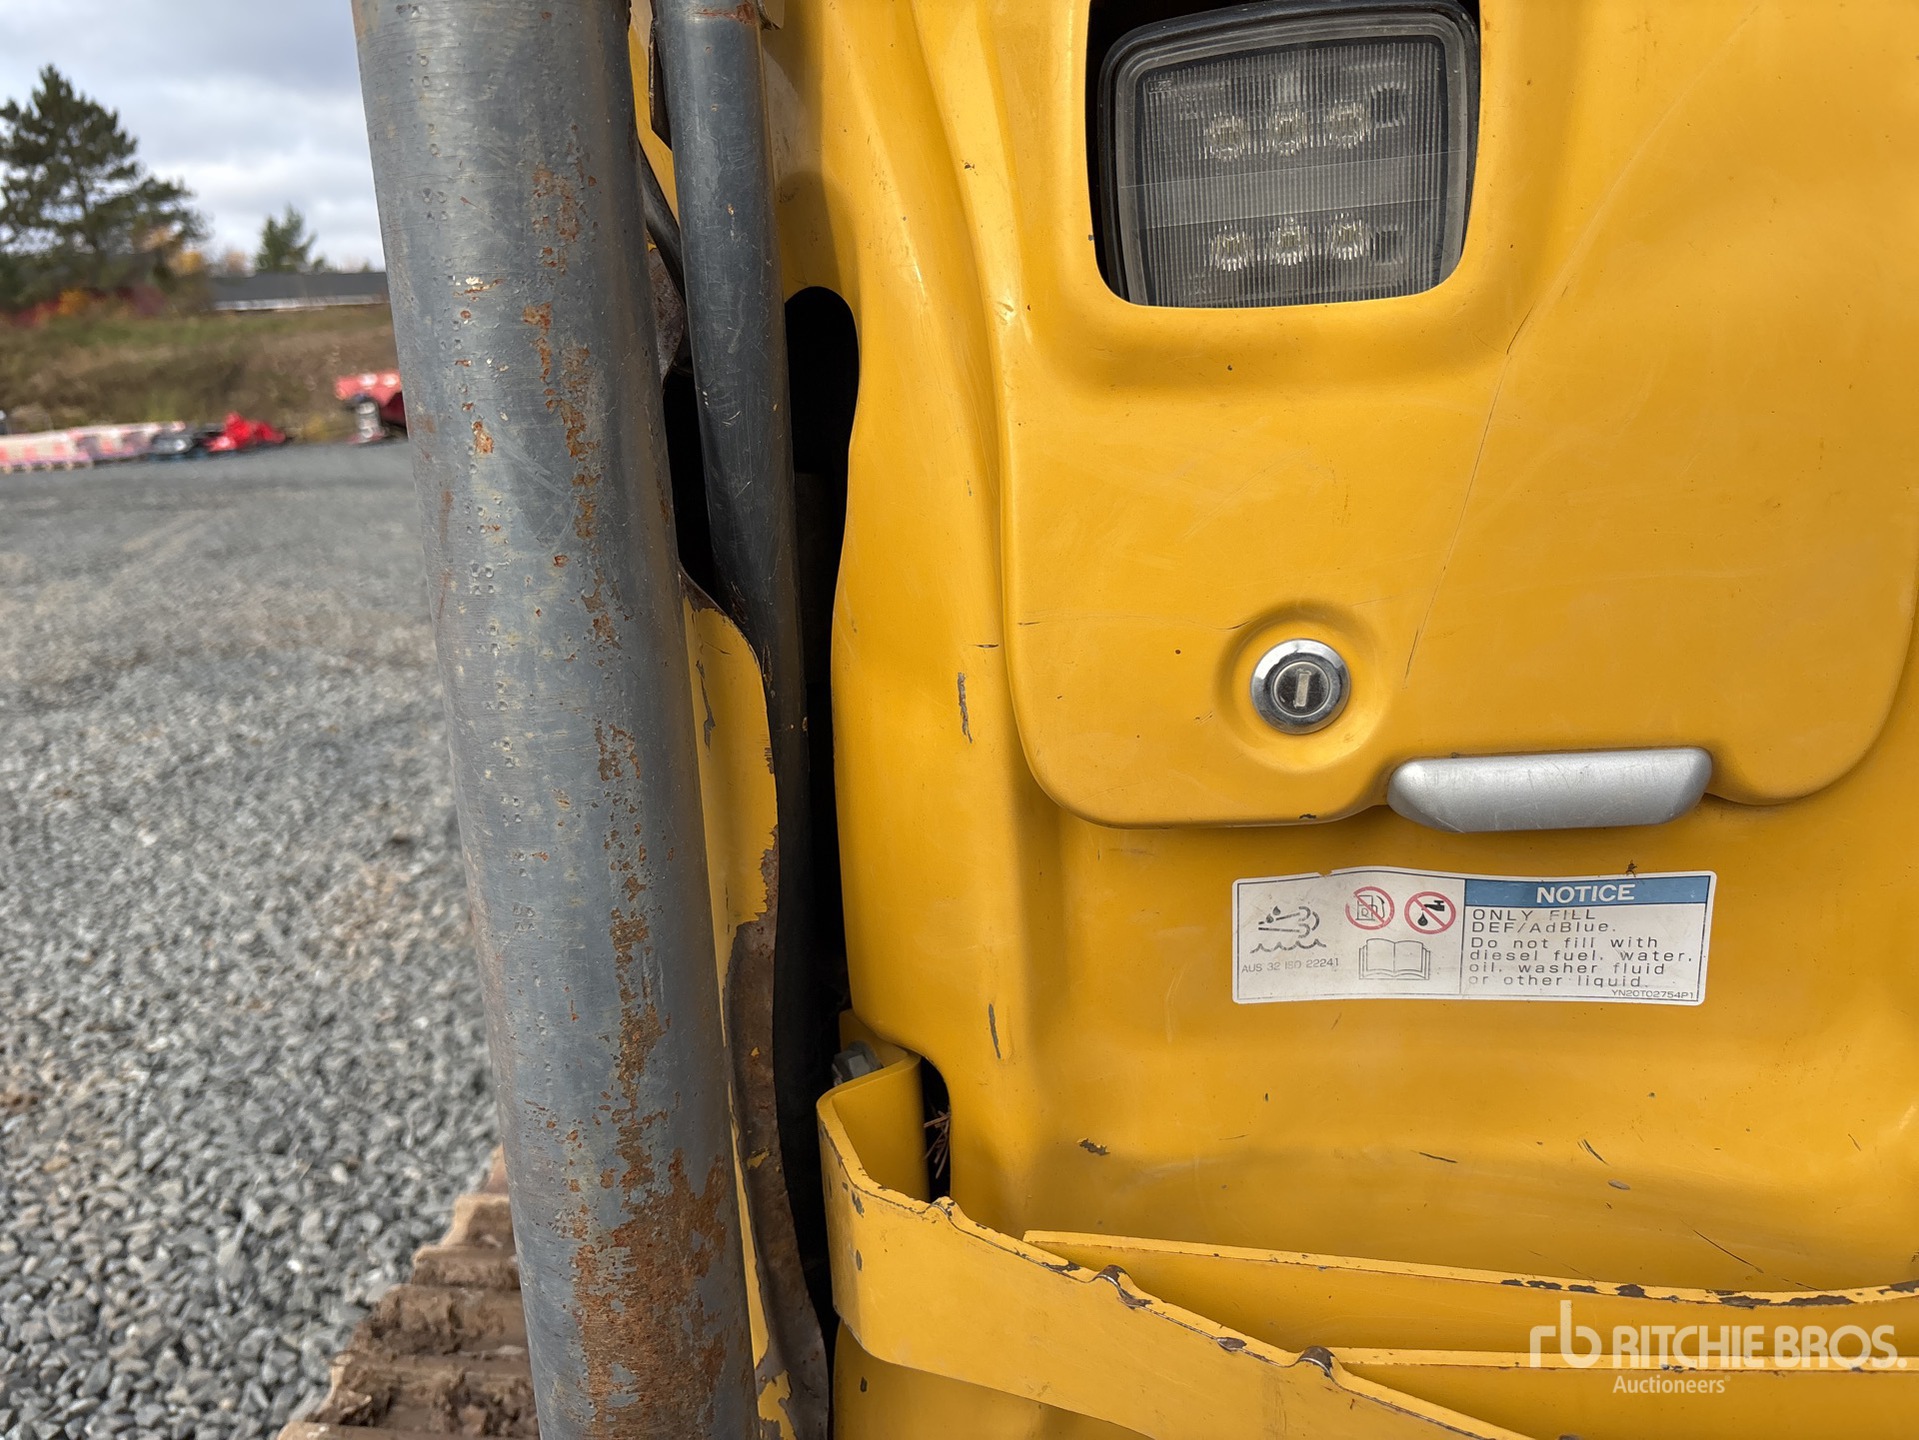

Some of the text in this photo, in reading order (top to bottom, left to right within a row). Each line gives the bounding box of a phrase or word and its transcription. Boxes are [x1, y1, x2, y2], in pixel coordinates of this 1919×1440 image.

[1536, 883, 1636, 904] NOTICE
[1472, 908, 1596, 921] ONLY FILL
[1471, 936, 1658, 949] Do not fill with
[1470, 951, 1538, 962] diesel
[1242, 958, 1339, 973] AUS 32 ISO 22241
[1518, 963, 1597, 974] washer
[1613, 963, 1665, 975] fluid
[1469, 976, 1489, 986] or
[1503, 975, 1563, 986] other
